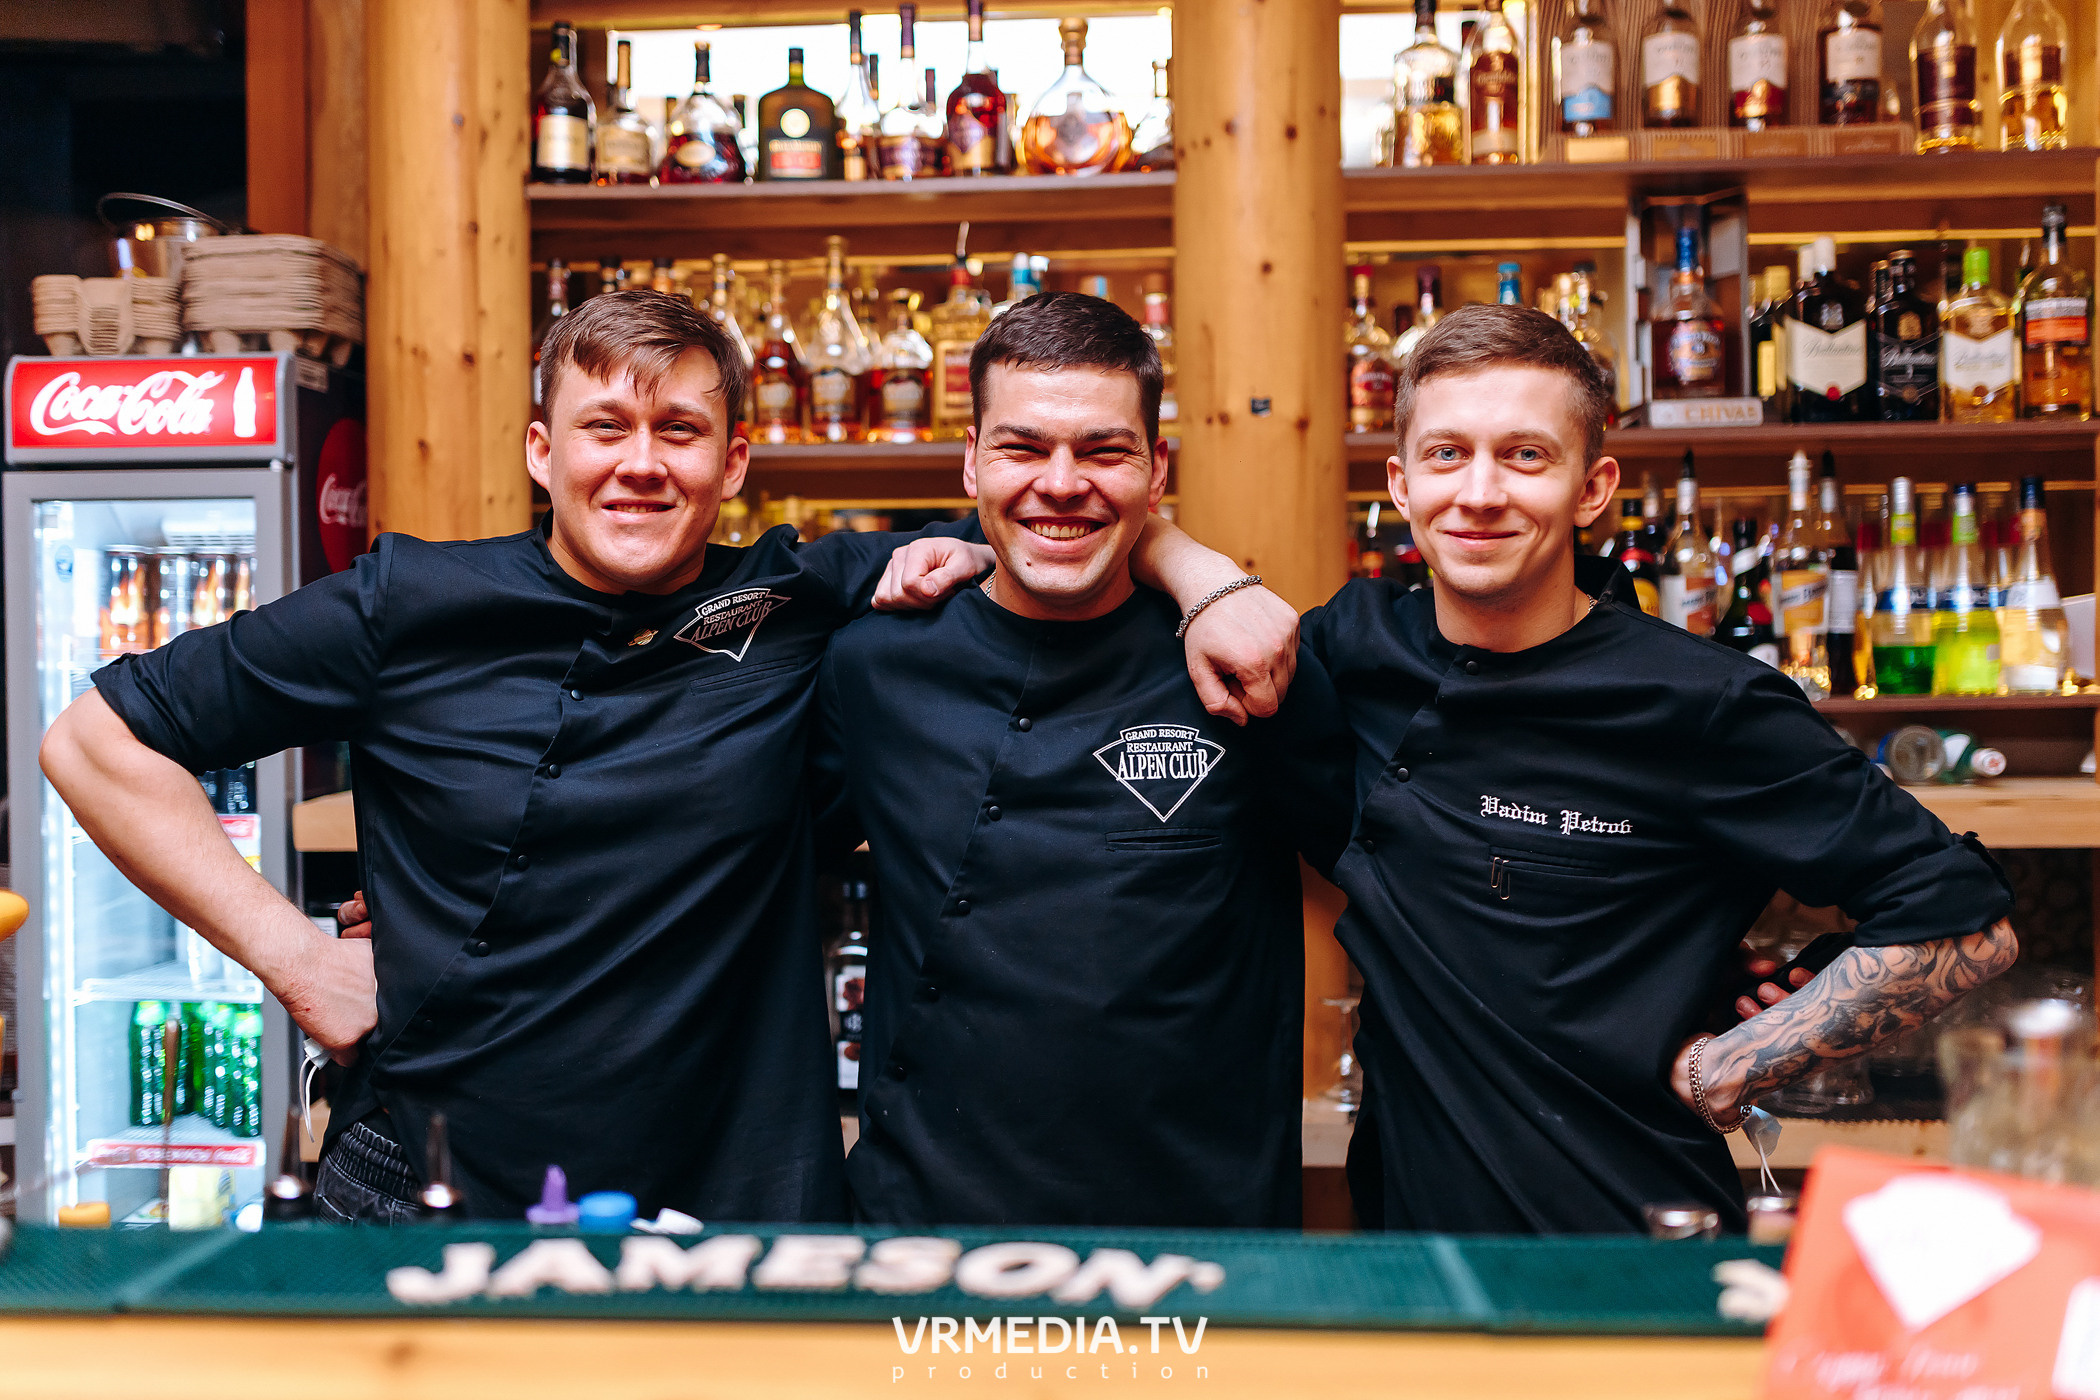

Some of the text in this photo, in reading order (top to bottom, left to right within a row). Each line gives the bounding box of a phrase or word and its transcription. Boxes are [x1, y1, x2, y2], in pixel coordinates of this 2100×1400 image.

[30, 371, 228, 436] Coca-Cola
[701, 591, 766, 617] GRAND RESORT
[703, 600, 764, 626] RESTAURANT
[689, 601, 773, 642] ALPEN CLUB
[1125, 728, 1195, 741] GRAND RESORT
[1126, 741, 1194, 753] RESTAURANT
[1116, 748, 1209, 781] ALPEN CLUB
[1480, 794, 1634, 836] Vadim Petrov
[386, 1233, 1200, 1312] JAMESON
